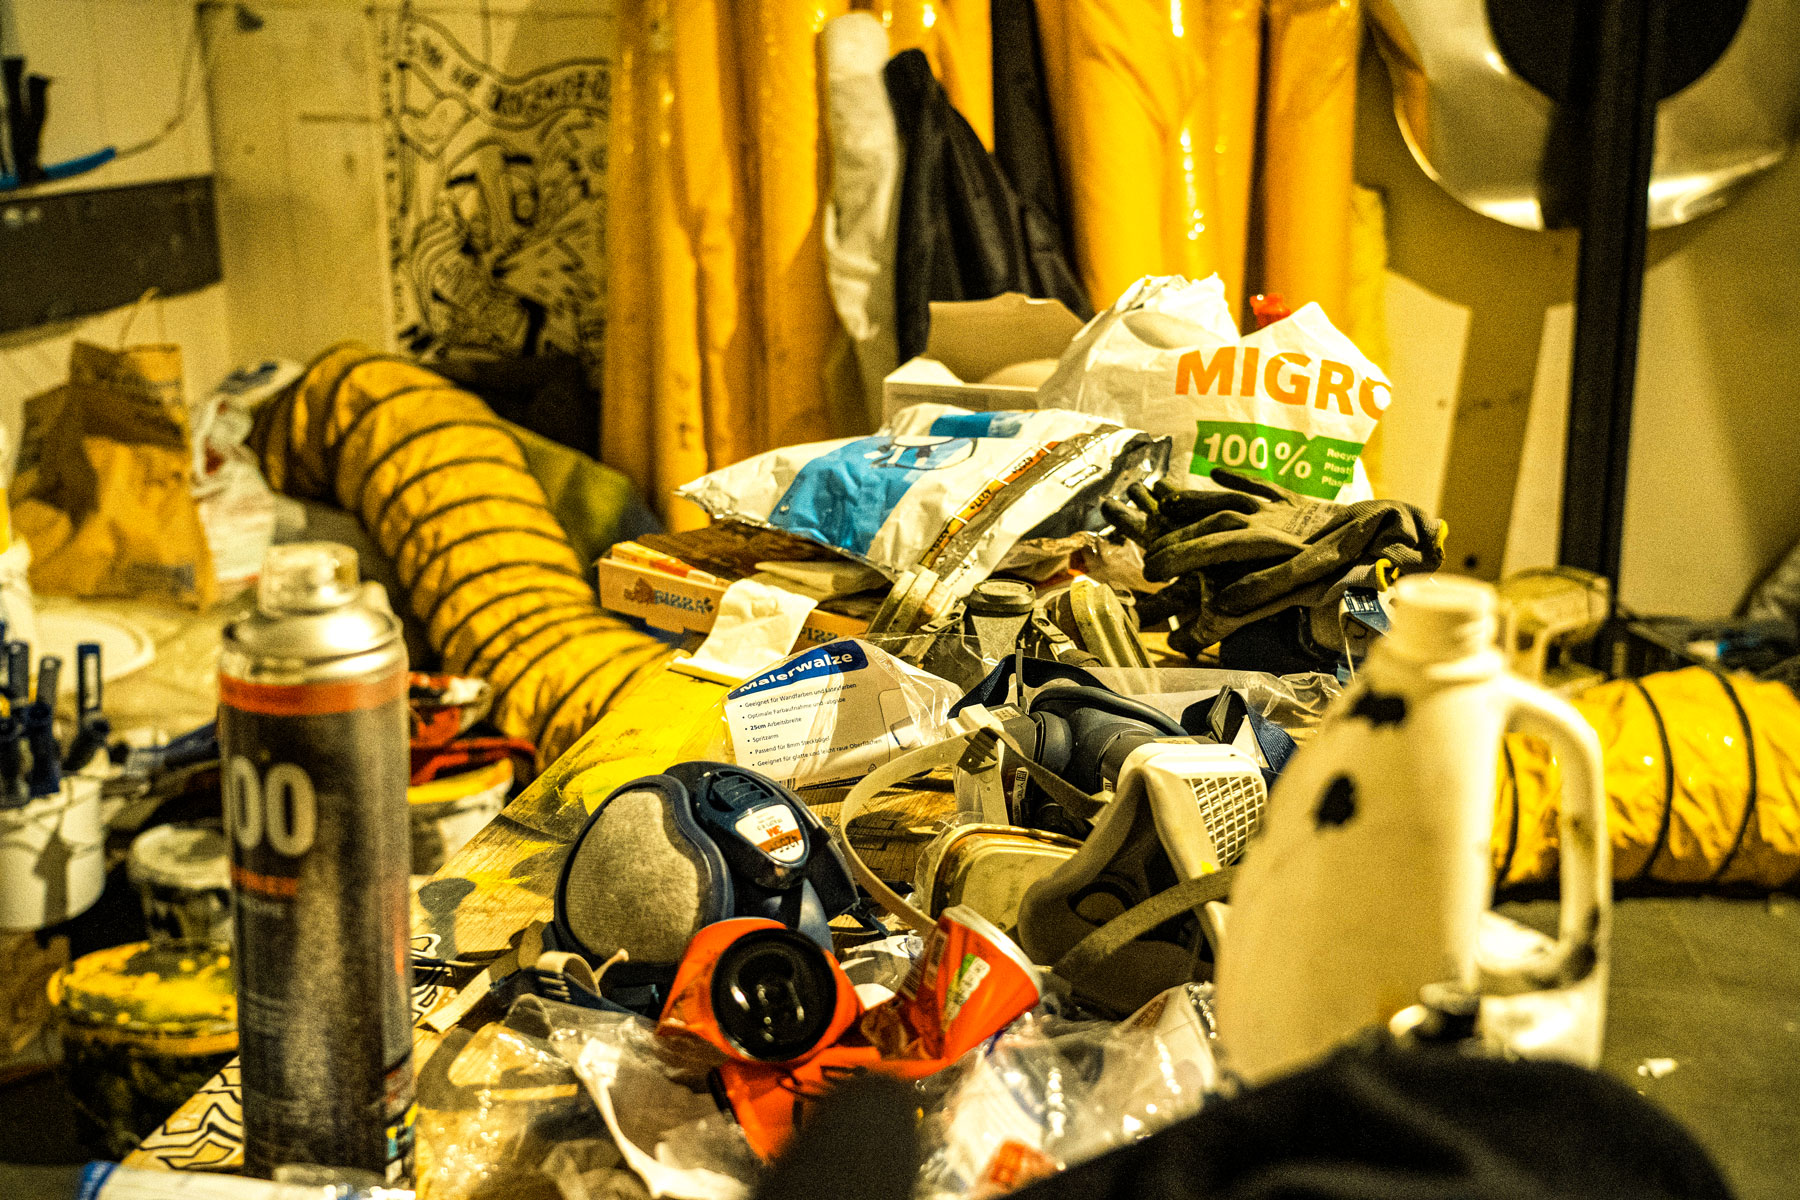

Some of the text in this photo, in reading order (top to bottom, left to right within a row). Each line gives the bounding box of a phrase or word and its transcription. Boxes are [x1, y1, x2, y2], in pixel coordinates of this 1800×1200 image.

[1203, 433, 1312, 479] 100%
[739, 653, 853, 693] Malerwalze
[744, 698, 770, 709] Geeignet
[780, 690, 813, 702] Wandfarben
[747, 710, 773, 719] Optimale
[773, 703, 811, 715] Farbaufnahme
[767, 717, 802, 728] Arbeitsbreite
[754, 744, 777, 754] Passend
[787, 741, 800, 749] 8mm
[757, 757, 782, 767] Geeignet
[792, 753, 808, 761] glatte
[765, 825, 783, 838] 3M
